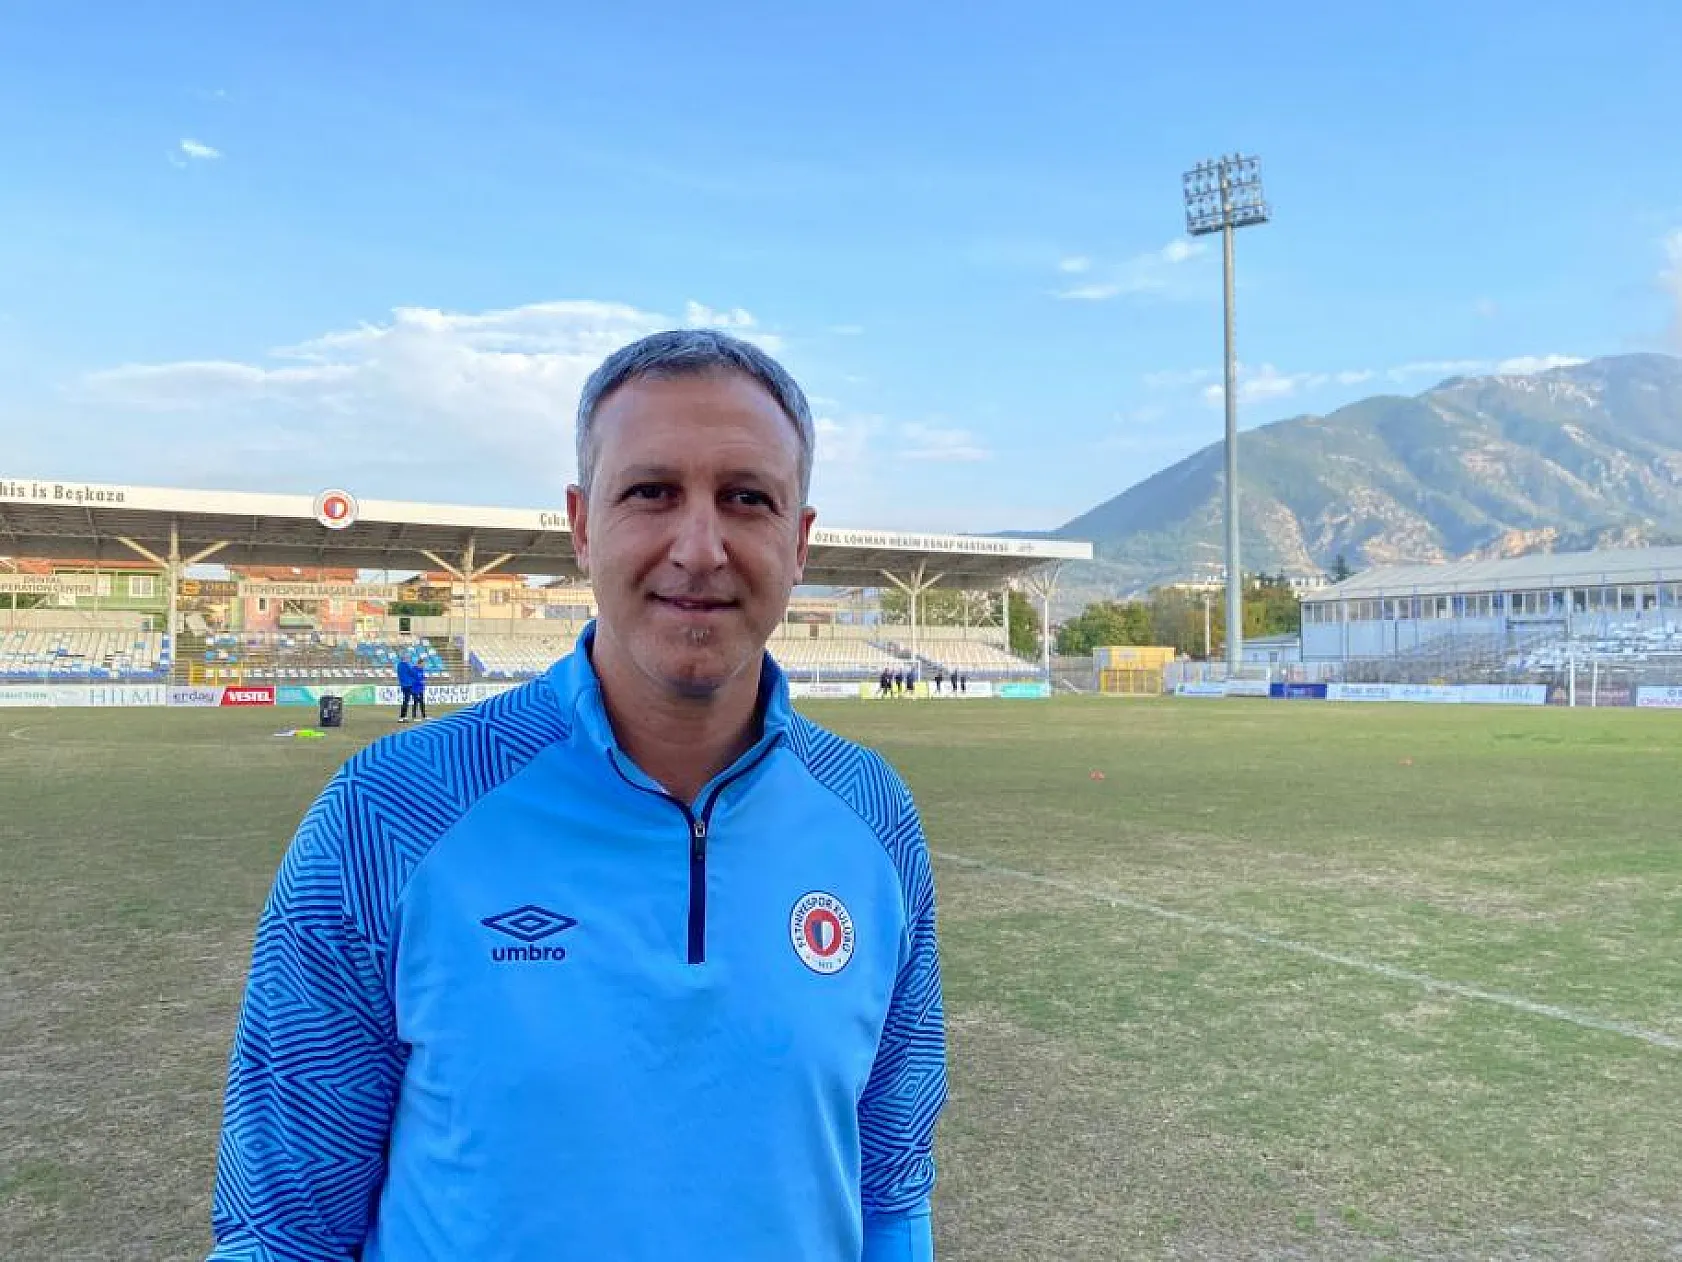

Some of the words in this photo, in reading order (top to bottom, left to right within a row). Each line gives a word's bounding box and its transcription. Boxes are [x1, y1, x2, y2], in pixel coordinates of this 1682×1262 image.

[814, 532, 842, 543] ÖZEL
[230, 691, 273, 702] VESTEL
[492, 944, 566, 961] umbro
